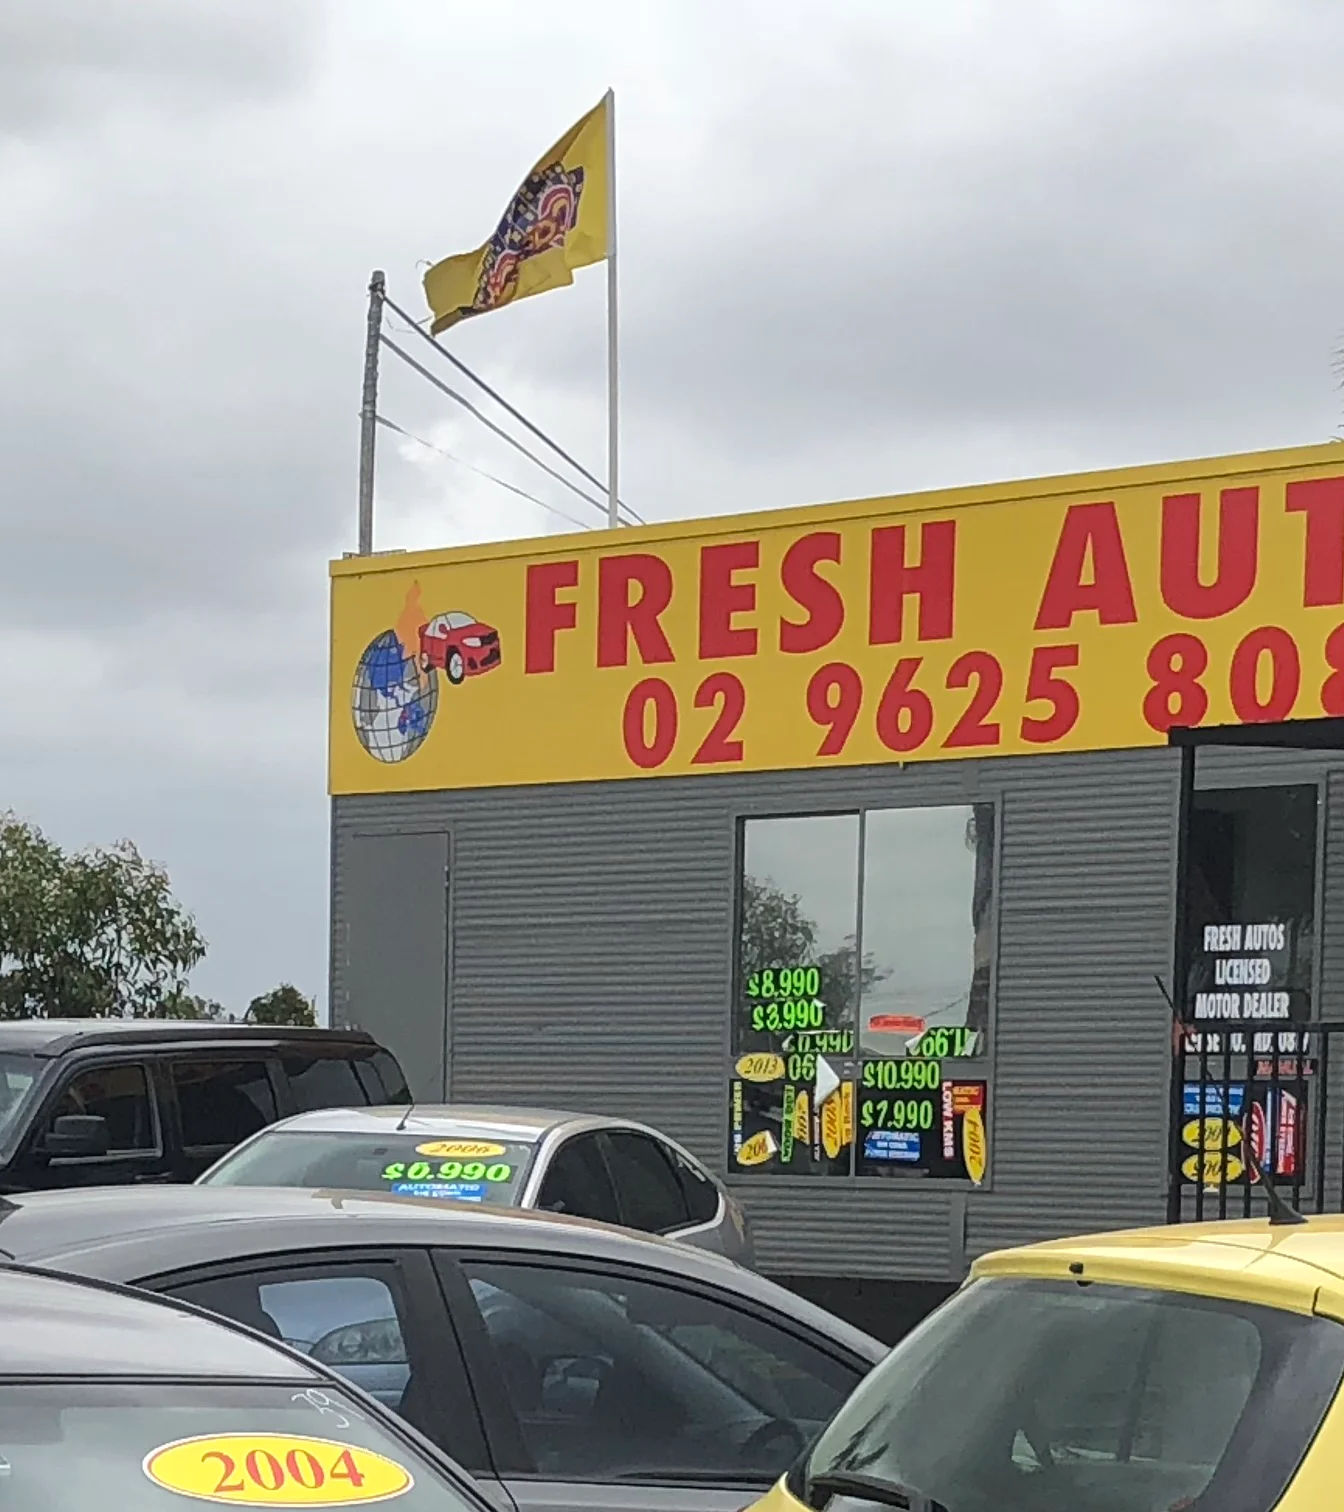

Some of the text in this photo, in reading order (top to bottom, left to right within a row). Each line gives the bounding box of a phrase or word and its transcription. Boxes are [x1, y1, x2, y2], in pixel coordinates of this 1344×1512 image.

[524, 519, 957, 674] FRESH
[622, 671, 746, 769] 02
[805, 643, 1081, 757] 9625
[1203, 923, 1285, 952] FRESH AUTOS
[745, 967, 820, 998] $8.990
[1215, 958, 1271, 985] LICENSED
[751, 999, 824, 1031] $3.990
[1194, 991, 1290, 1019] MOTOR DEALER
[862, 1061, 940, 1090] $10.990
[860, 1099, 934, 1129] $7.990
[199, 1447, 366, 1494] 2004
